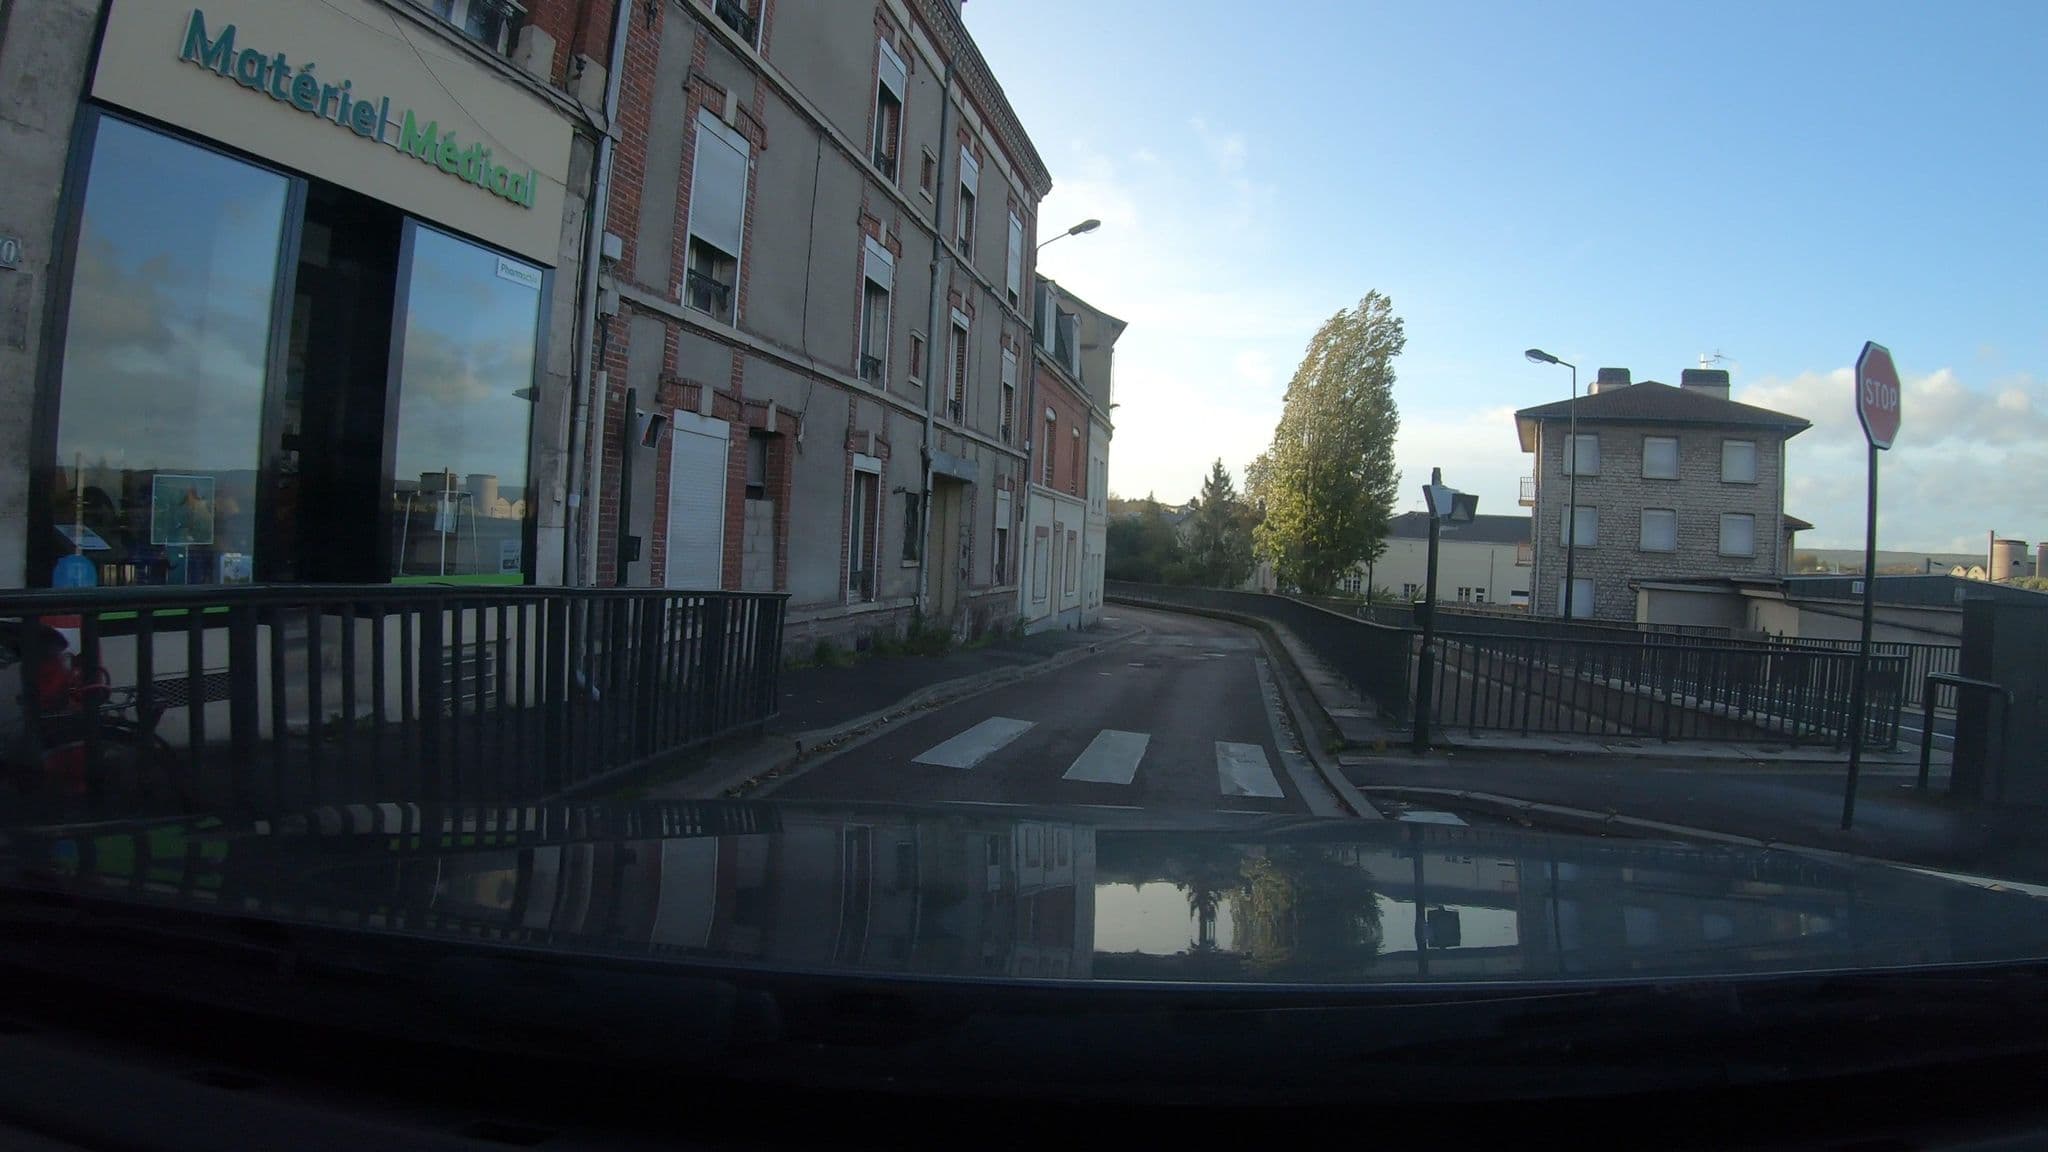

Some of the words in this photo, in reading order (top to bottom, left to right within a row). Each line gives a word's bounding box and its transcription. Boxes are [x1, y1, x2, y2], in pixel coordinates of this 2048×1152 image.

[180, 8, 391, 143] Matériel
[400, 109, 538, 209] Médical
[1865, 378, 1897, 411] STOP
